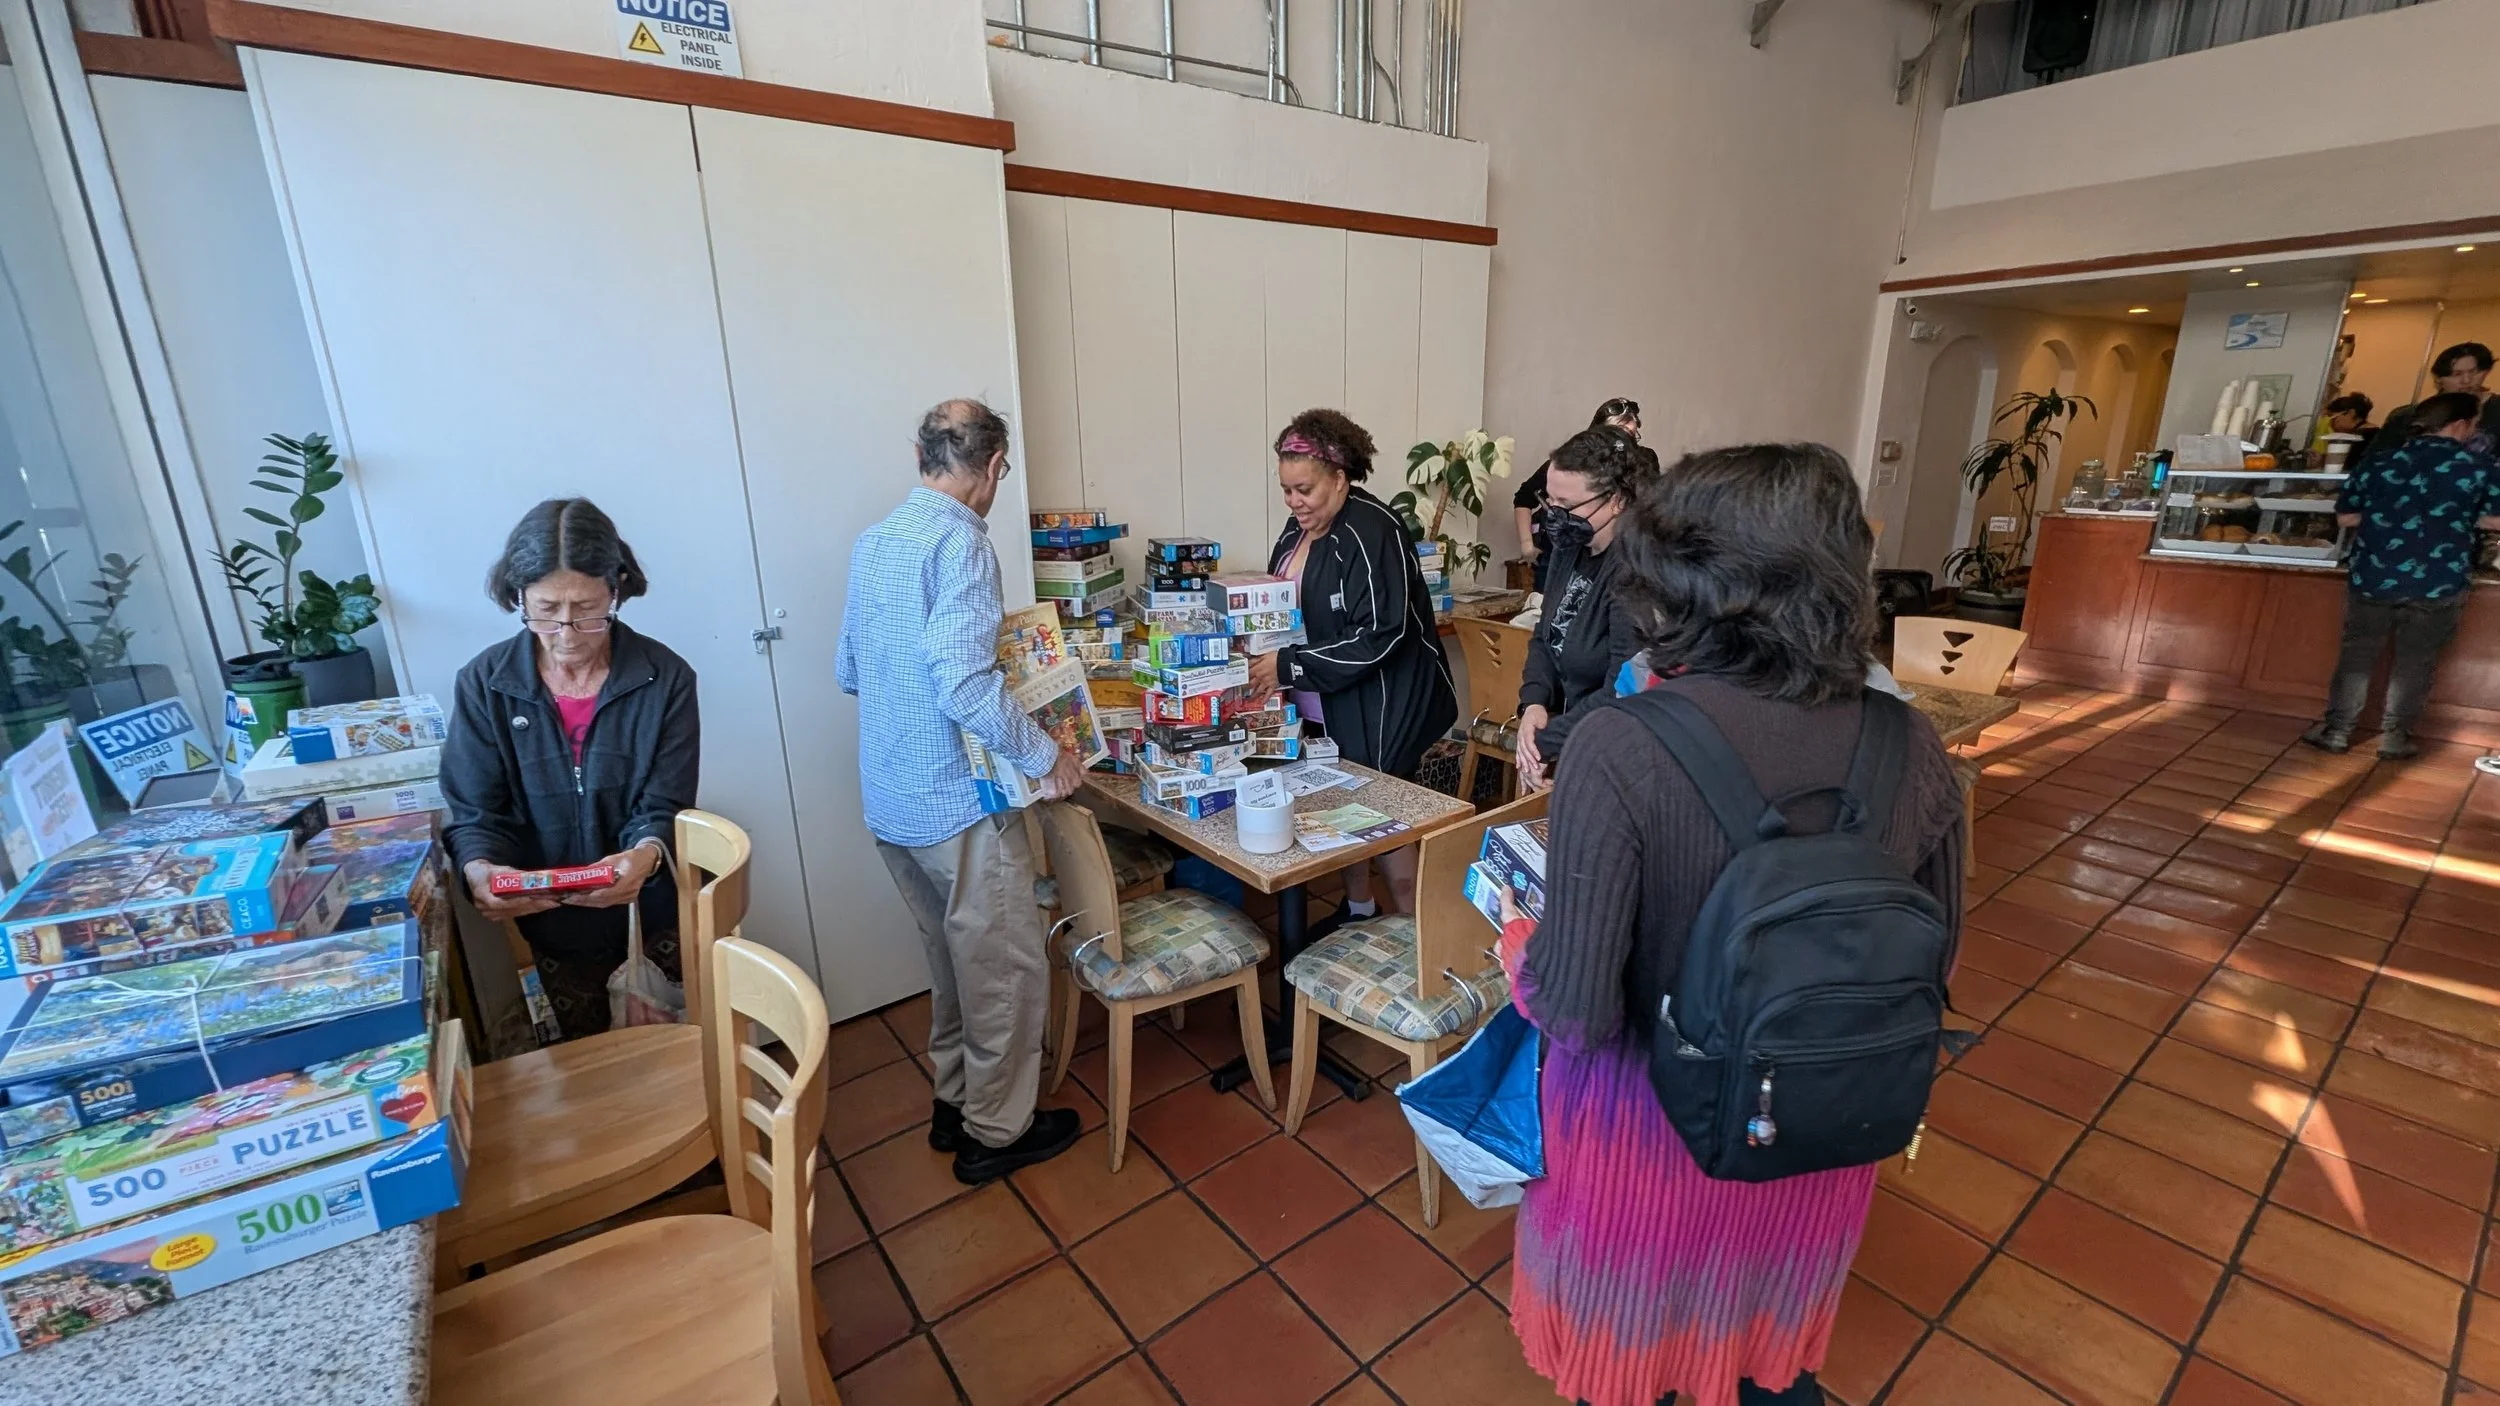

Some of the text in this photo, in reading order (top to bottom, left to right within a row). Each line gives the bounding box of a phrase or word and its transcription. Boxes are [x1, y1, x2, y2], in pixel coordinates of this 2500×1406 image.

[660, 21, 732, 45] ELECTRICAL
[679, 39, 719, 56] PANEL
[681, 54, 723, 71] INSIDE
[1028, 673, 1076, 706] OAKLAN
[1185, 778, 1207, 792] 1000
[496, 876, 520, 888] 500
[1467, 872, 1477, 896] 1000
[236, 898, 252, 930] CEACO
[79, 1082, 126, 1105] 500
[87, 1167, 167, 1207] 500
[179, 1157, 220, 1174] PIECE
[231, 1108, 368, 1165] PUZZLE
[370, 1152, 443, 1180] Ravensburger
[235, 1193, 322, 1244] 500
[243, 1209, 368, 1255] Ravensburger Puzzle
[167, 1236, 198, 1252] Large
[170, 1244, 200, 1258] Piece
[165, 1248, 205, 1268] Format
